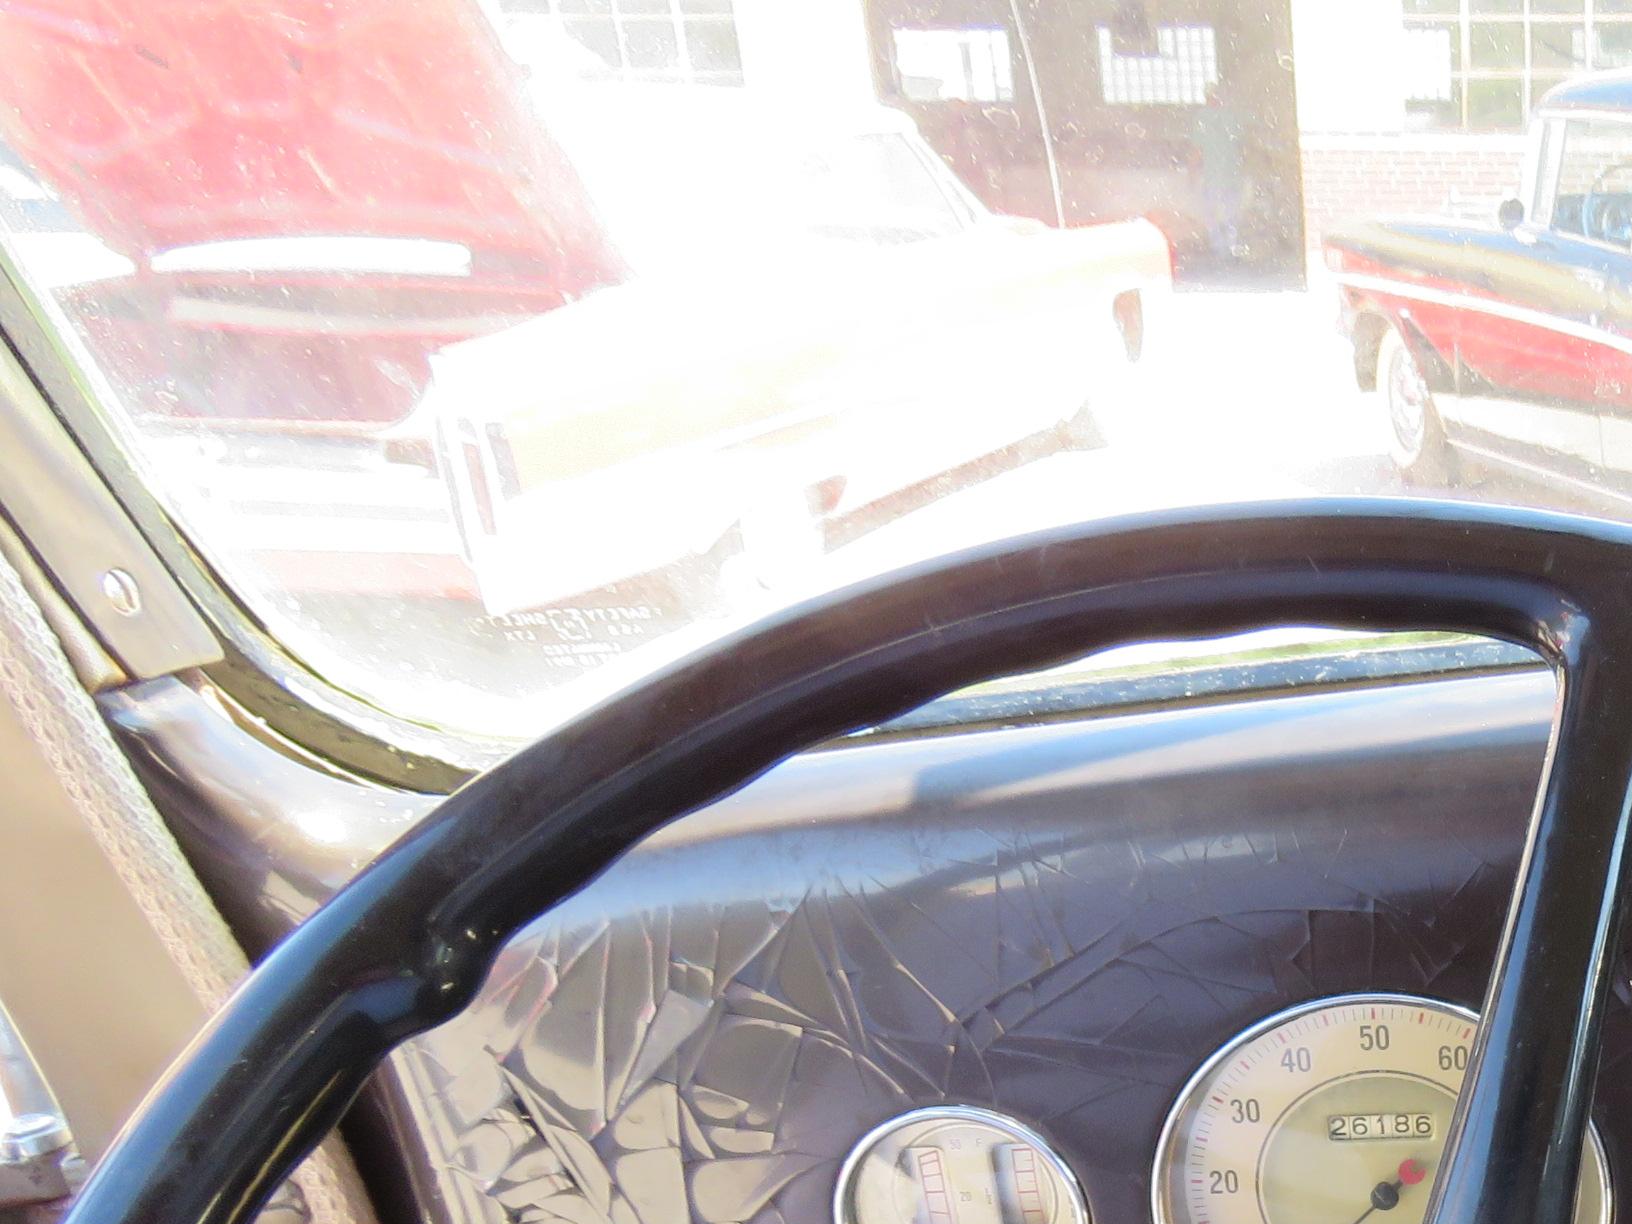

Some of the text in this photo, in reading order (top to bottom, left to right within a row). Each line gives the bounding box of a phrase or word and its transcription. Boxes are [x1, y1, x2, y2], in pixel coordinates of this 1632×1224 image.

[1359, 1025, 1390, 1051] 50
[1280, 1047, 1312, 1073] 40
[1438, 1045, 1468, 1071] 60
[1230, 1099, 1261, 1124] 30
[1331, 1114, 1432, 1137] 26186
[1209, 1170, 1239, 1195] 20
